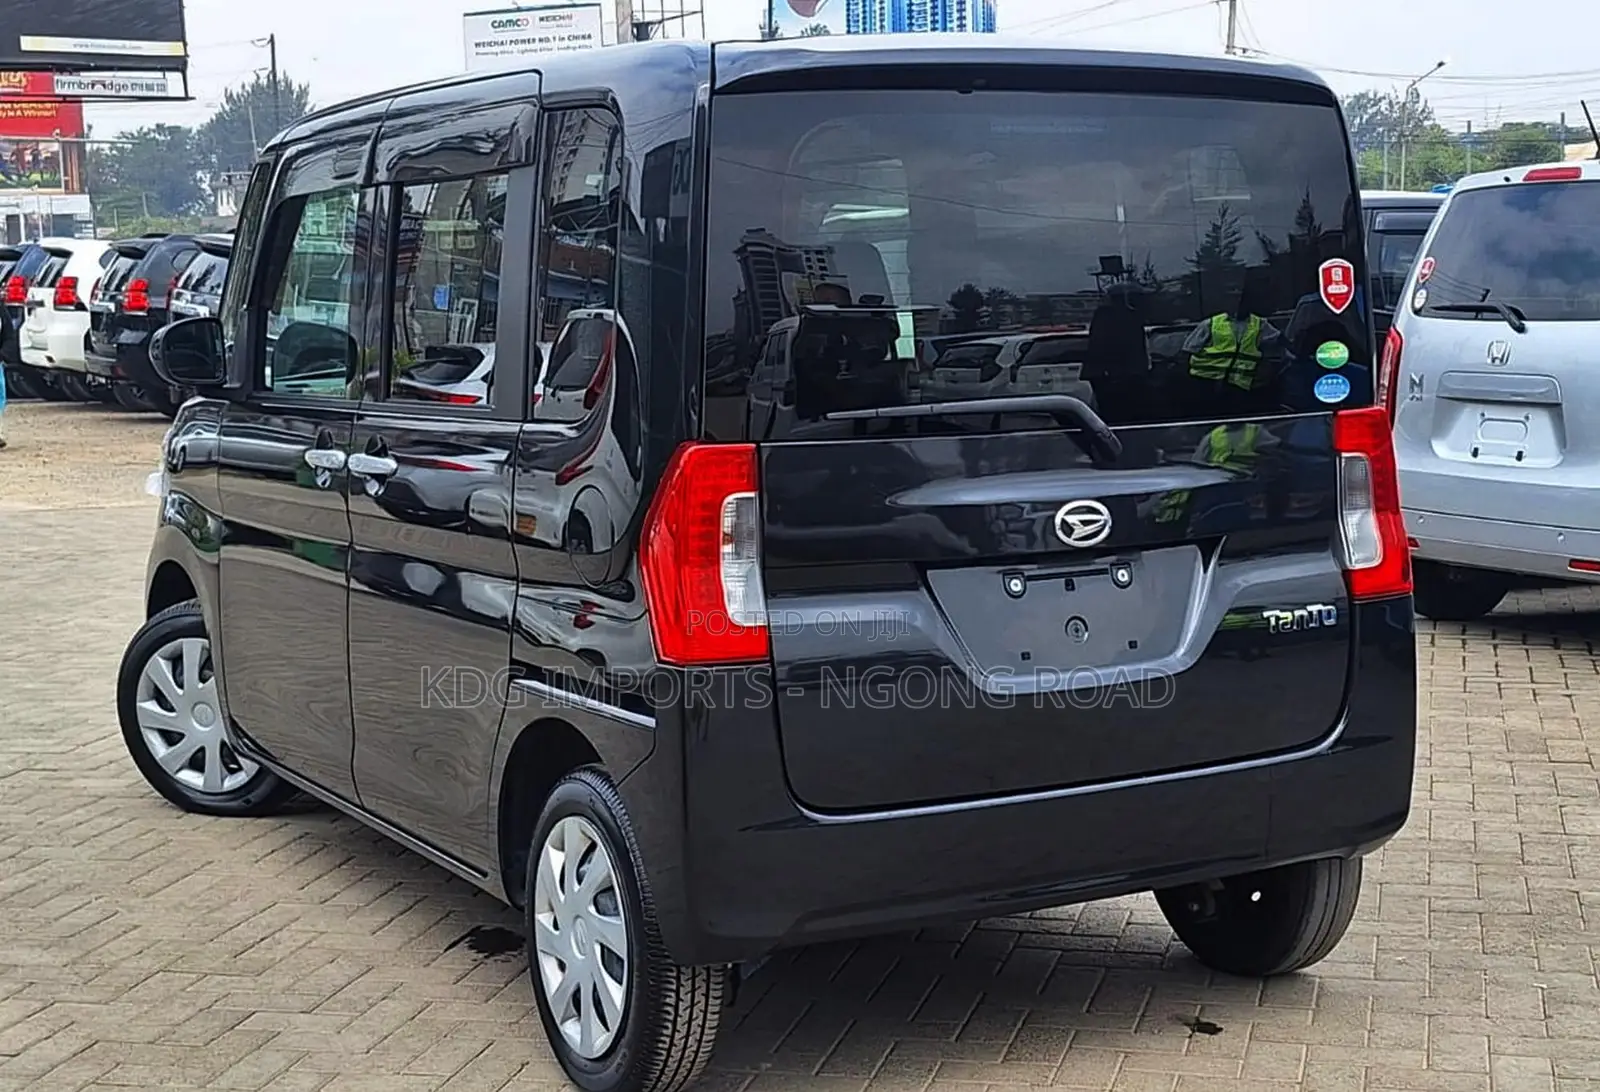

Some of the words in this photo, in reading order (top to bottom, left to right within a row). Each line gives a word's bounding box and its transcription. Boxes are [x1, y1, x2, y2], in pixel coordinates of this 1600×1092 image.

[491, 18, 530, 29] CAMCO
[509, 37, 536, 46] POWER
[567, 33, 592, 42] CHINA
